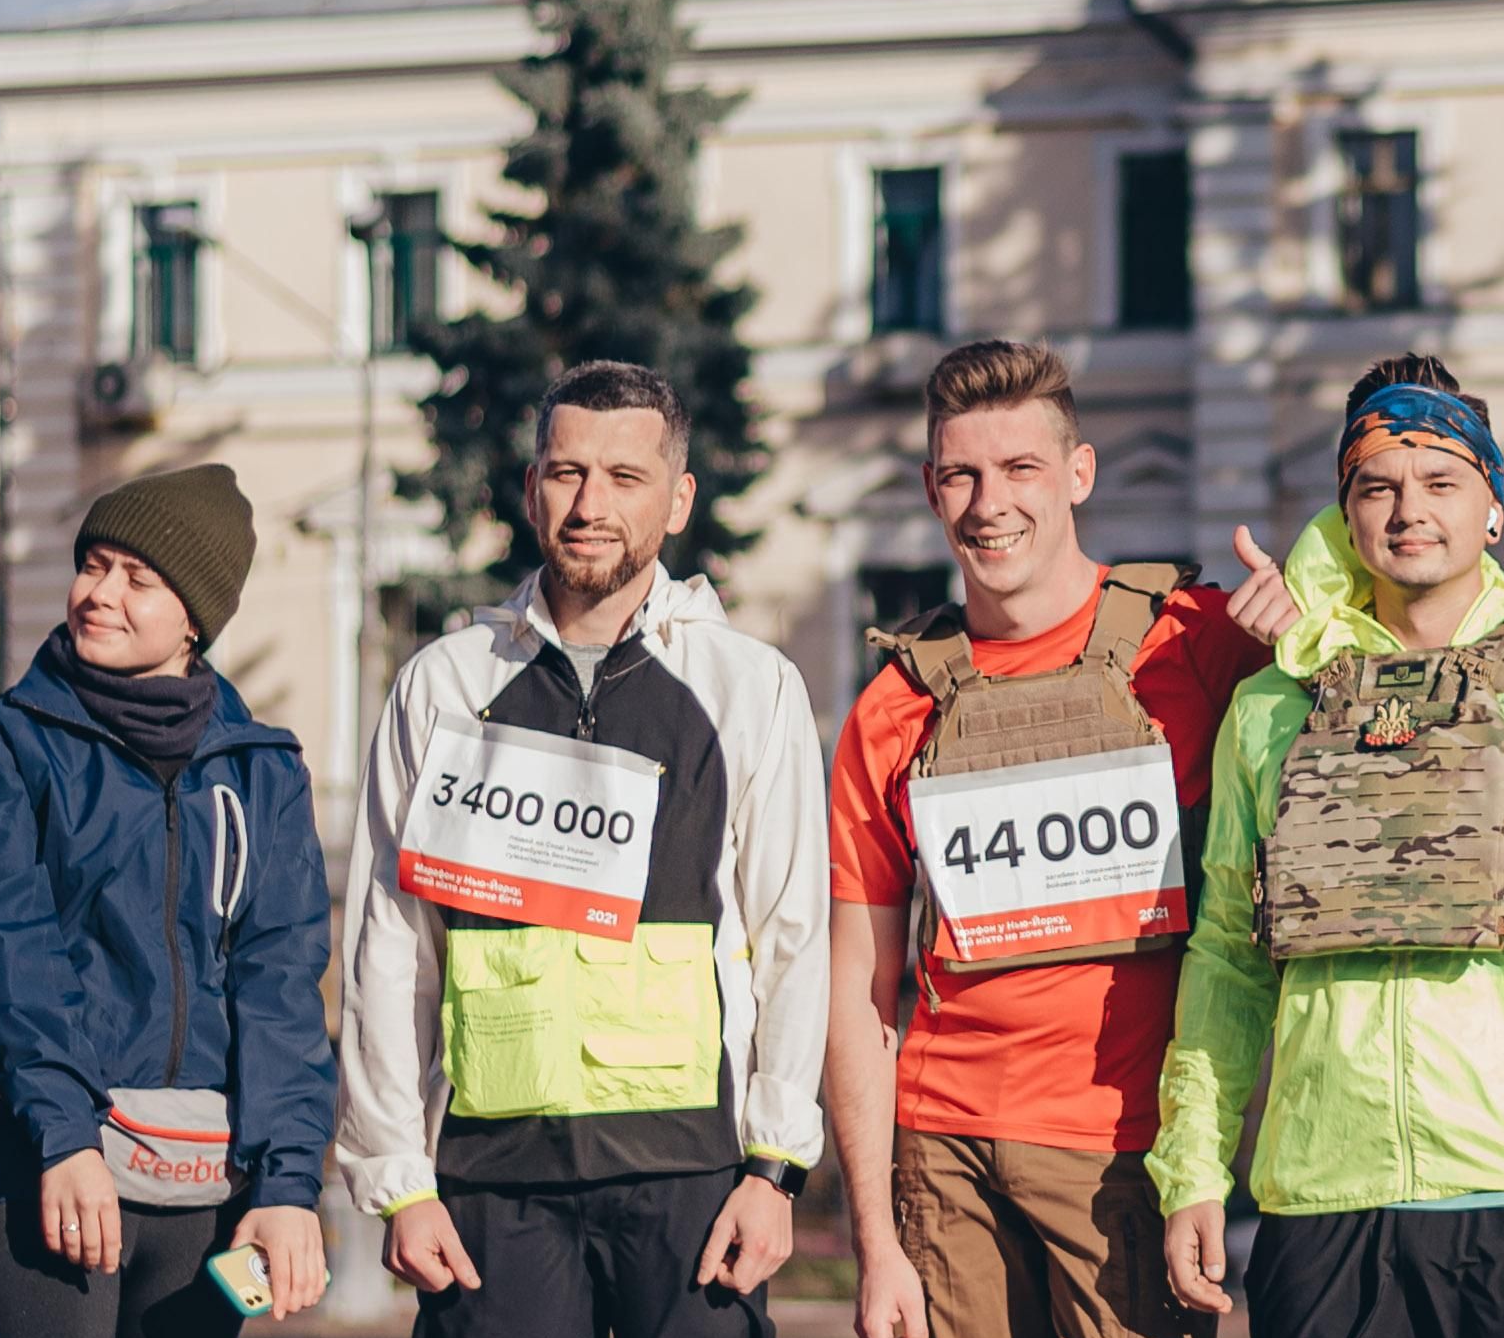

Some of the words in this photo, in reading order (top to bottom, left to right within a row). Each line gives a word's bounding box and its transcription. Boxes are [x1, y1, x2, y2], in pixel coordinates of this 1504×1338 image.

[554, 799, 635, 845] 000
[944, 819, 1025, 875] 44
[1037, 799, 1159, 862] 000
[586, 907, 618, 927] 2021
[1138, 906, 1169, 922] 2021
[997, 923, 1005, 933] у
[1004, 931, 1018, 942] не
[1019, 928, 1043, 940] хоче
[1044, 923, 1072, 936] бігти
[127, 1144, 225, 1183] Reebo
